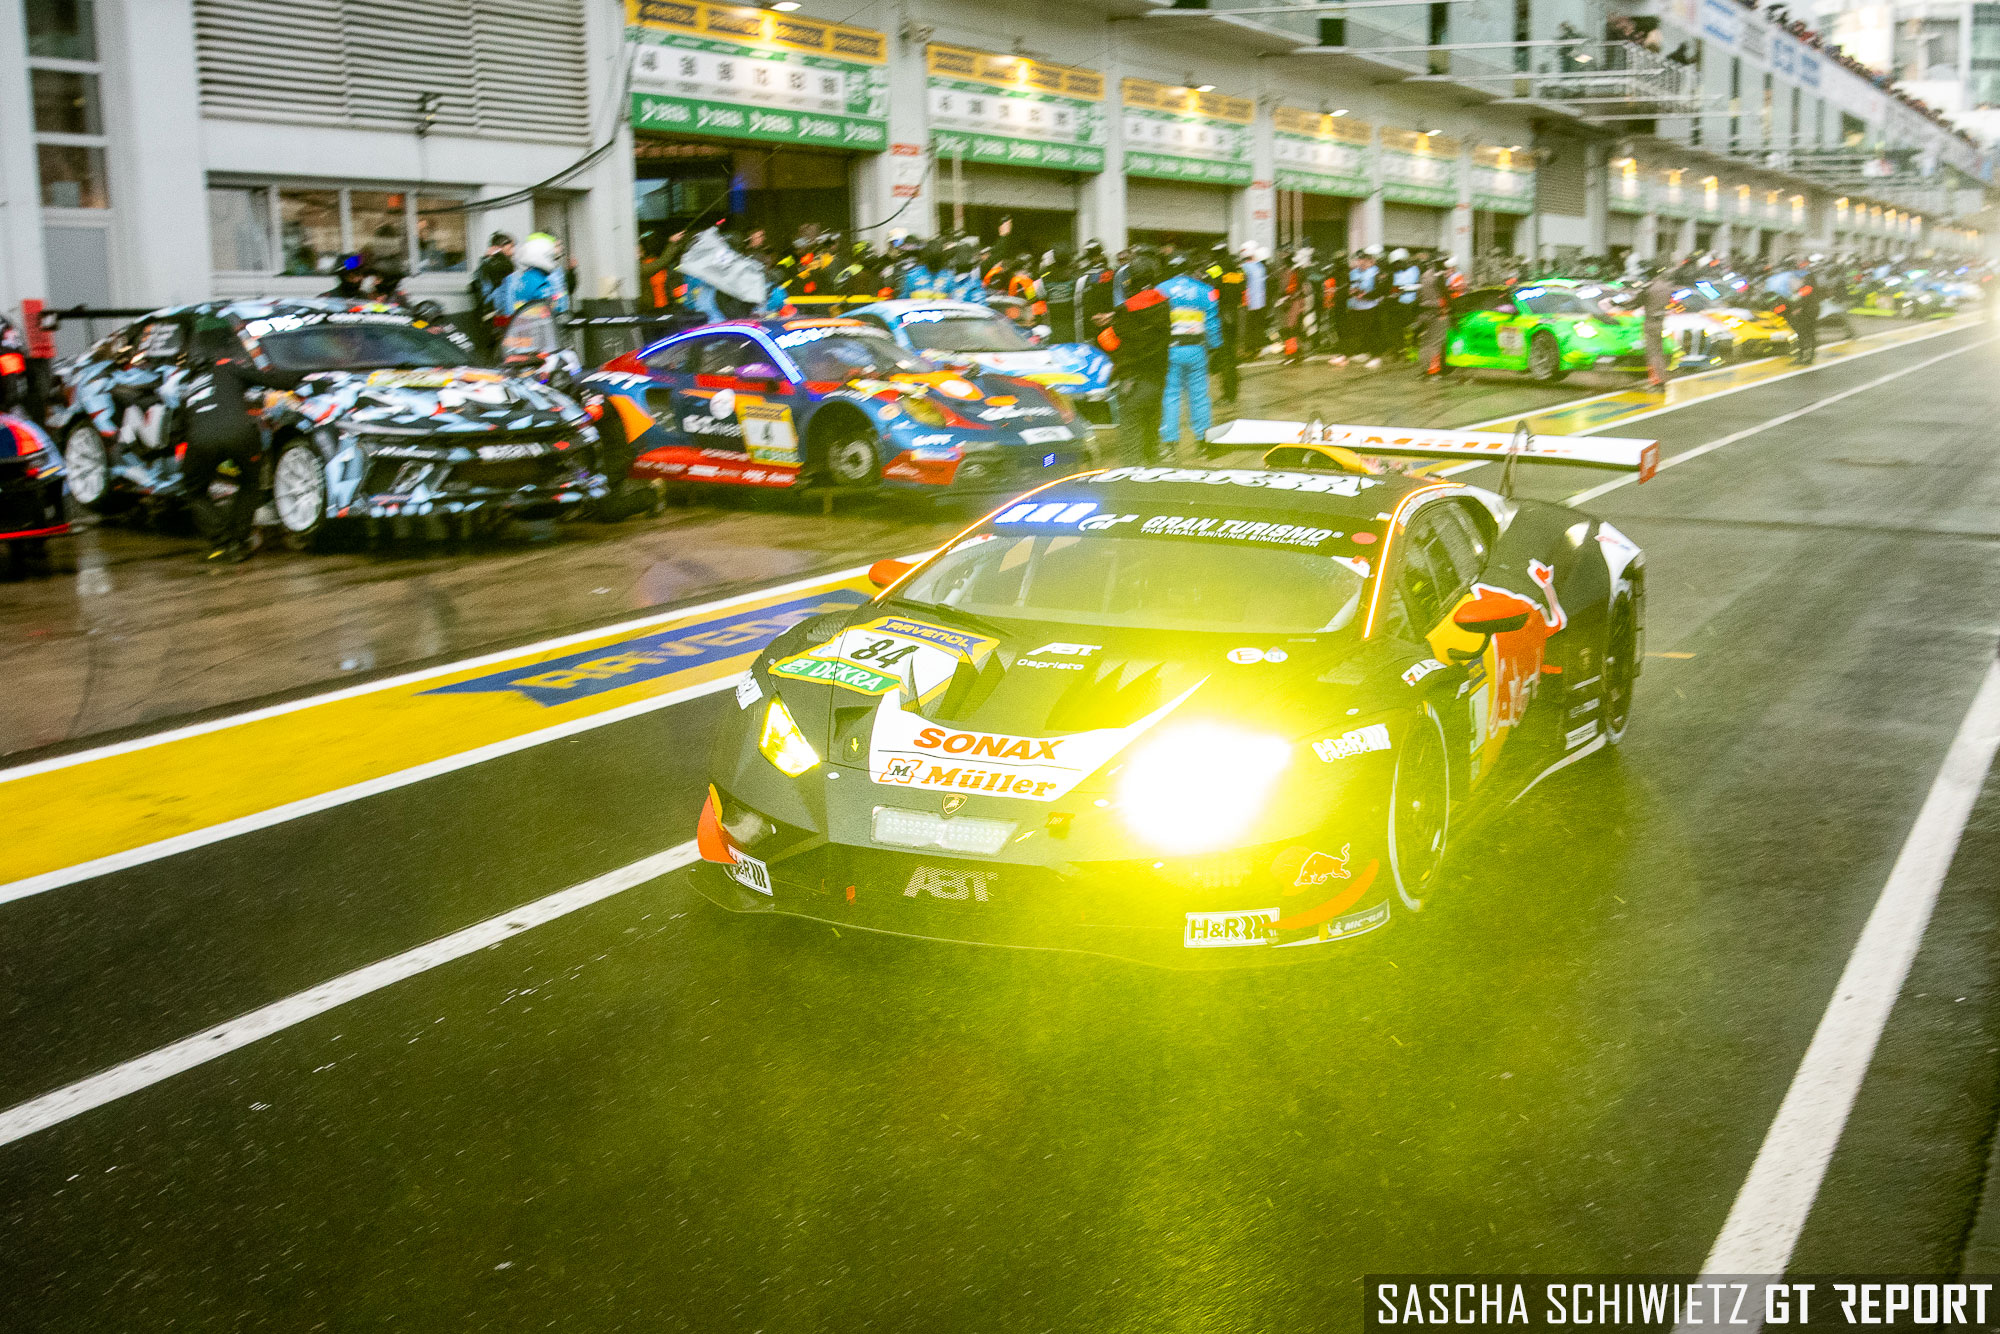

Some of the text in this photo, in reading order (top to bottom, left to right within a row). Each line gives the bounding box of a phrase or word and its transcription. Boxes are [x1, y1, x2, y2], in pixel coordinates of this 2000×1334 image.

[1141, 515, 1334, 542] GRAN TURISMO
[1165, 528, 1196, 536] REAL
[1197, 530, 1247, 540] DRIVING
[1247, 534, 1320, 548] SIMULATOR
[885, 621, 969, 649] RAVENOL
[1026, 642, 1102, 656] ABT
[850, 638, 920, 669] 84
[1017, 658, 1084, 671] Capristo
[807, 661, 884, 692] DEKRA
[913, 728, 1064, 760] SONAX
[1312, 730, 1364, 763] H&R
[921, 766, 1057, 797] Müller
[903, 865, 998, 902] ABT
[1190, 917, 1241, 941] H&R
